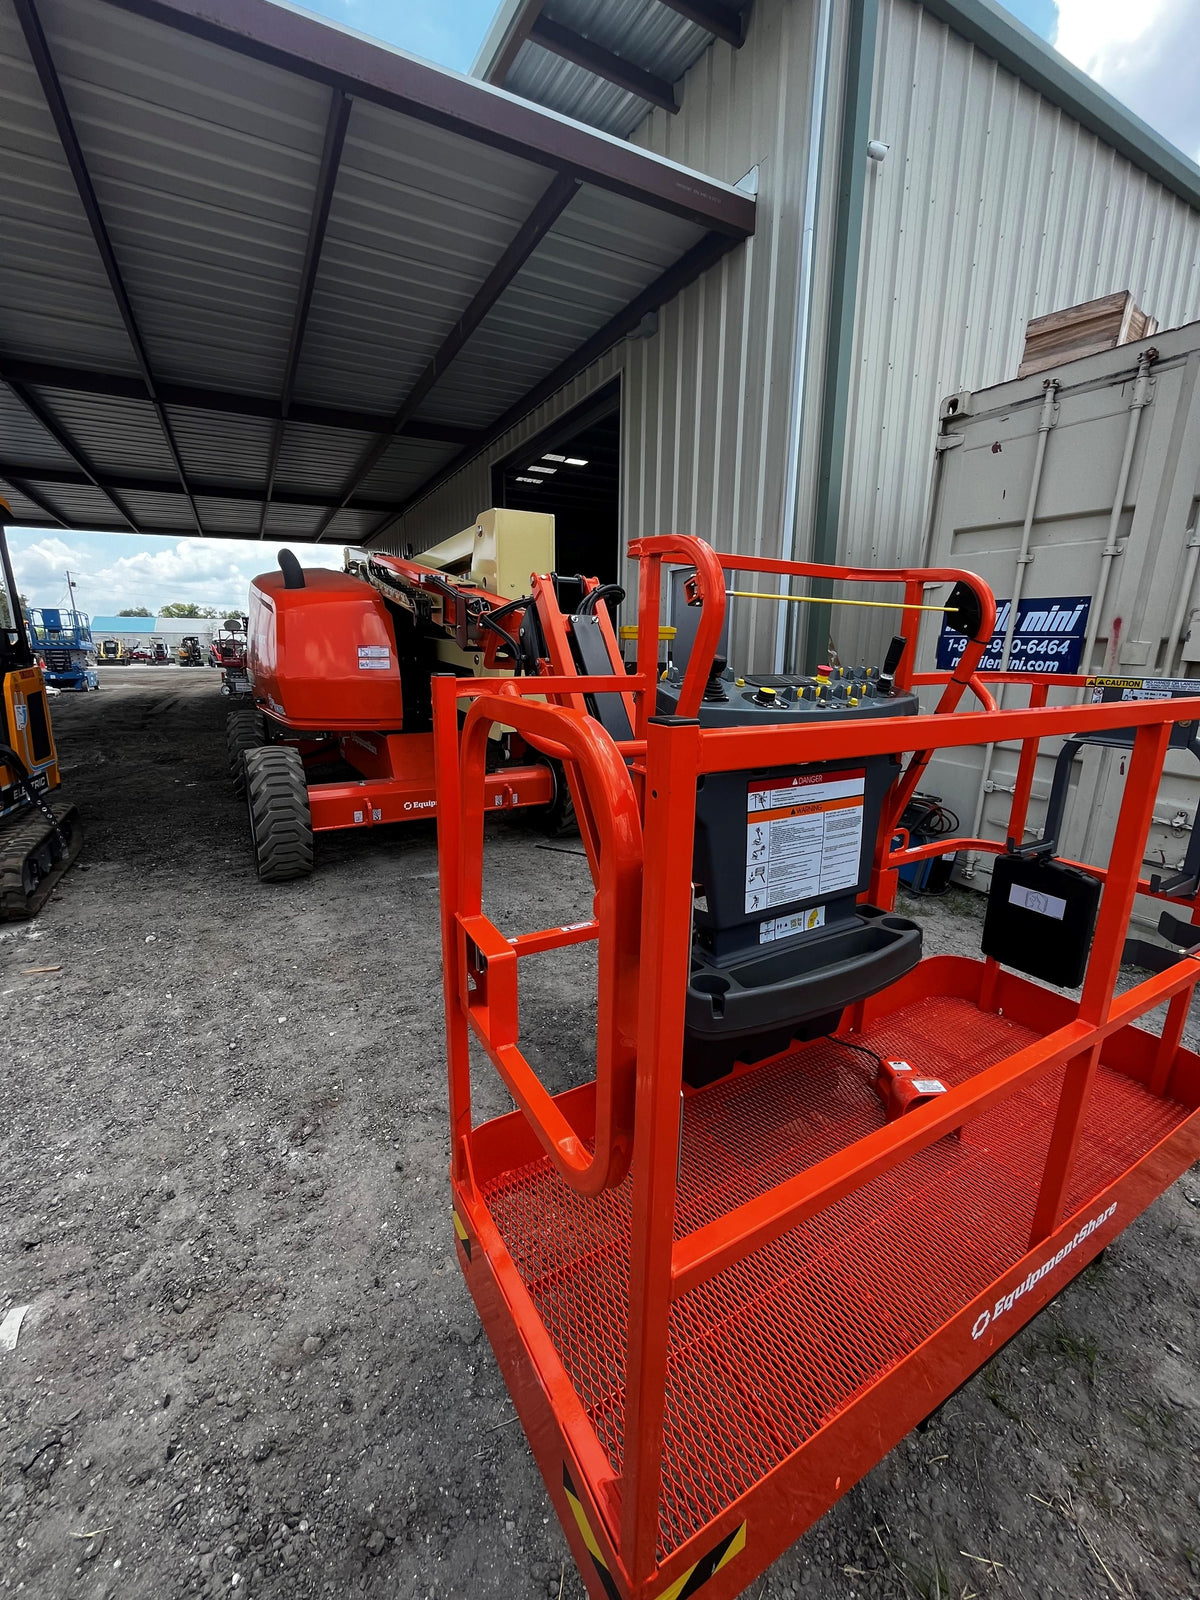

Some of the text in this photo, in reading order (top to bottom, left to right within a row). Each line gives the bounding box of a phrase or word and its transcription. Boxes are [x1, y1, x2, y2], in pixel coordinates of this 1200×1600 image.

[1019, 604, 1085, 632] mini
[947, 638, 1070, 655] 1-8-90-6464
[950, 655, 1060, 672] milemini.com
[1105, 679, 1141, 688] CAUTION
[13, 776, 46, 800] ELETRIC
[798, 774, 823, 785] DANGER
[413, 800, 437, 809] Equip
[797, 804, 822, 814] WARNING
[992, 1201, 1118, 1321] EquipmentShare
